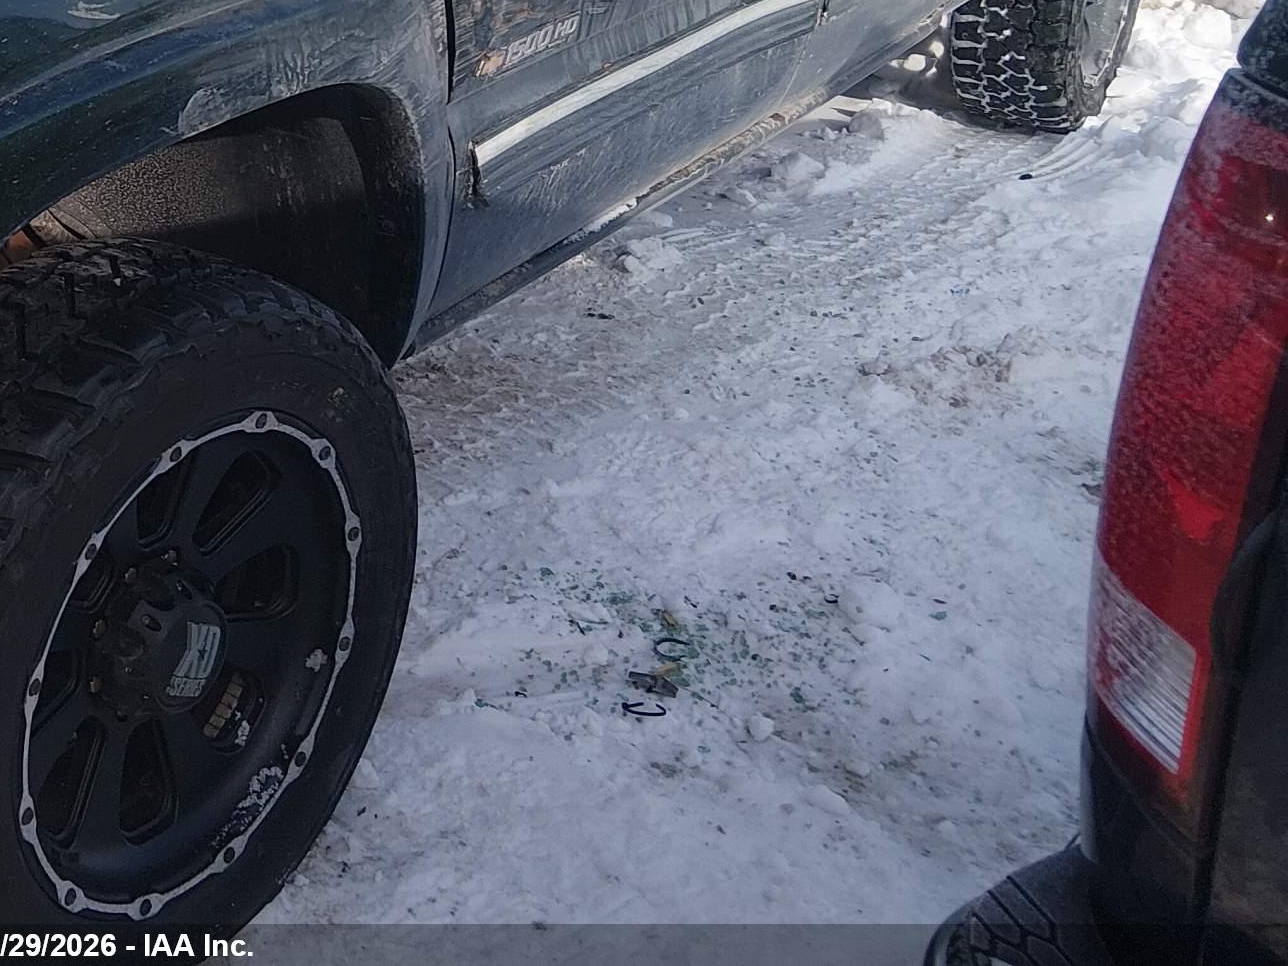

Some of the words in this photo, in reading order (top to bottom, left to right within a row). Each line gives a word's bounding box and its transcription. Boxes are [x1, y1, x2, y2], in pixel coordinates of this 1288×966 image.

[505, 24, 554, 66] 1500
[554, 15, 580, 41] HD
[173, 621, 221, 679] XD
